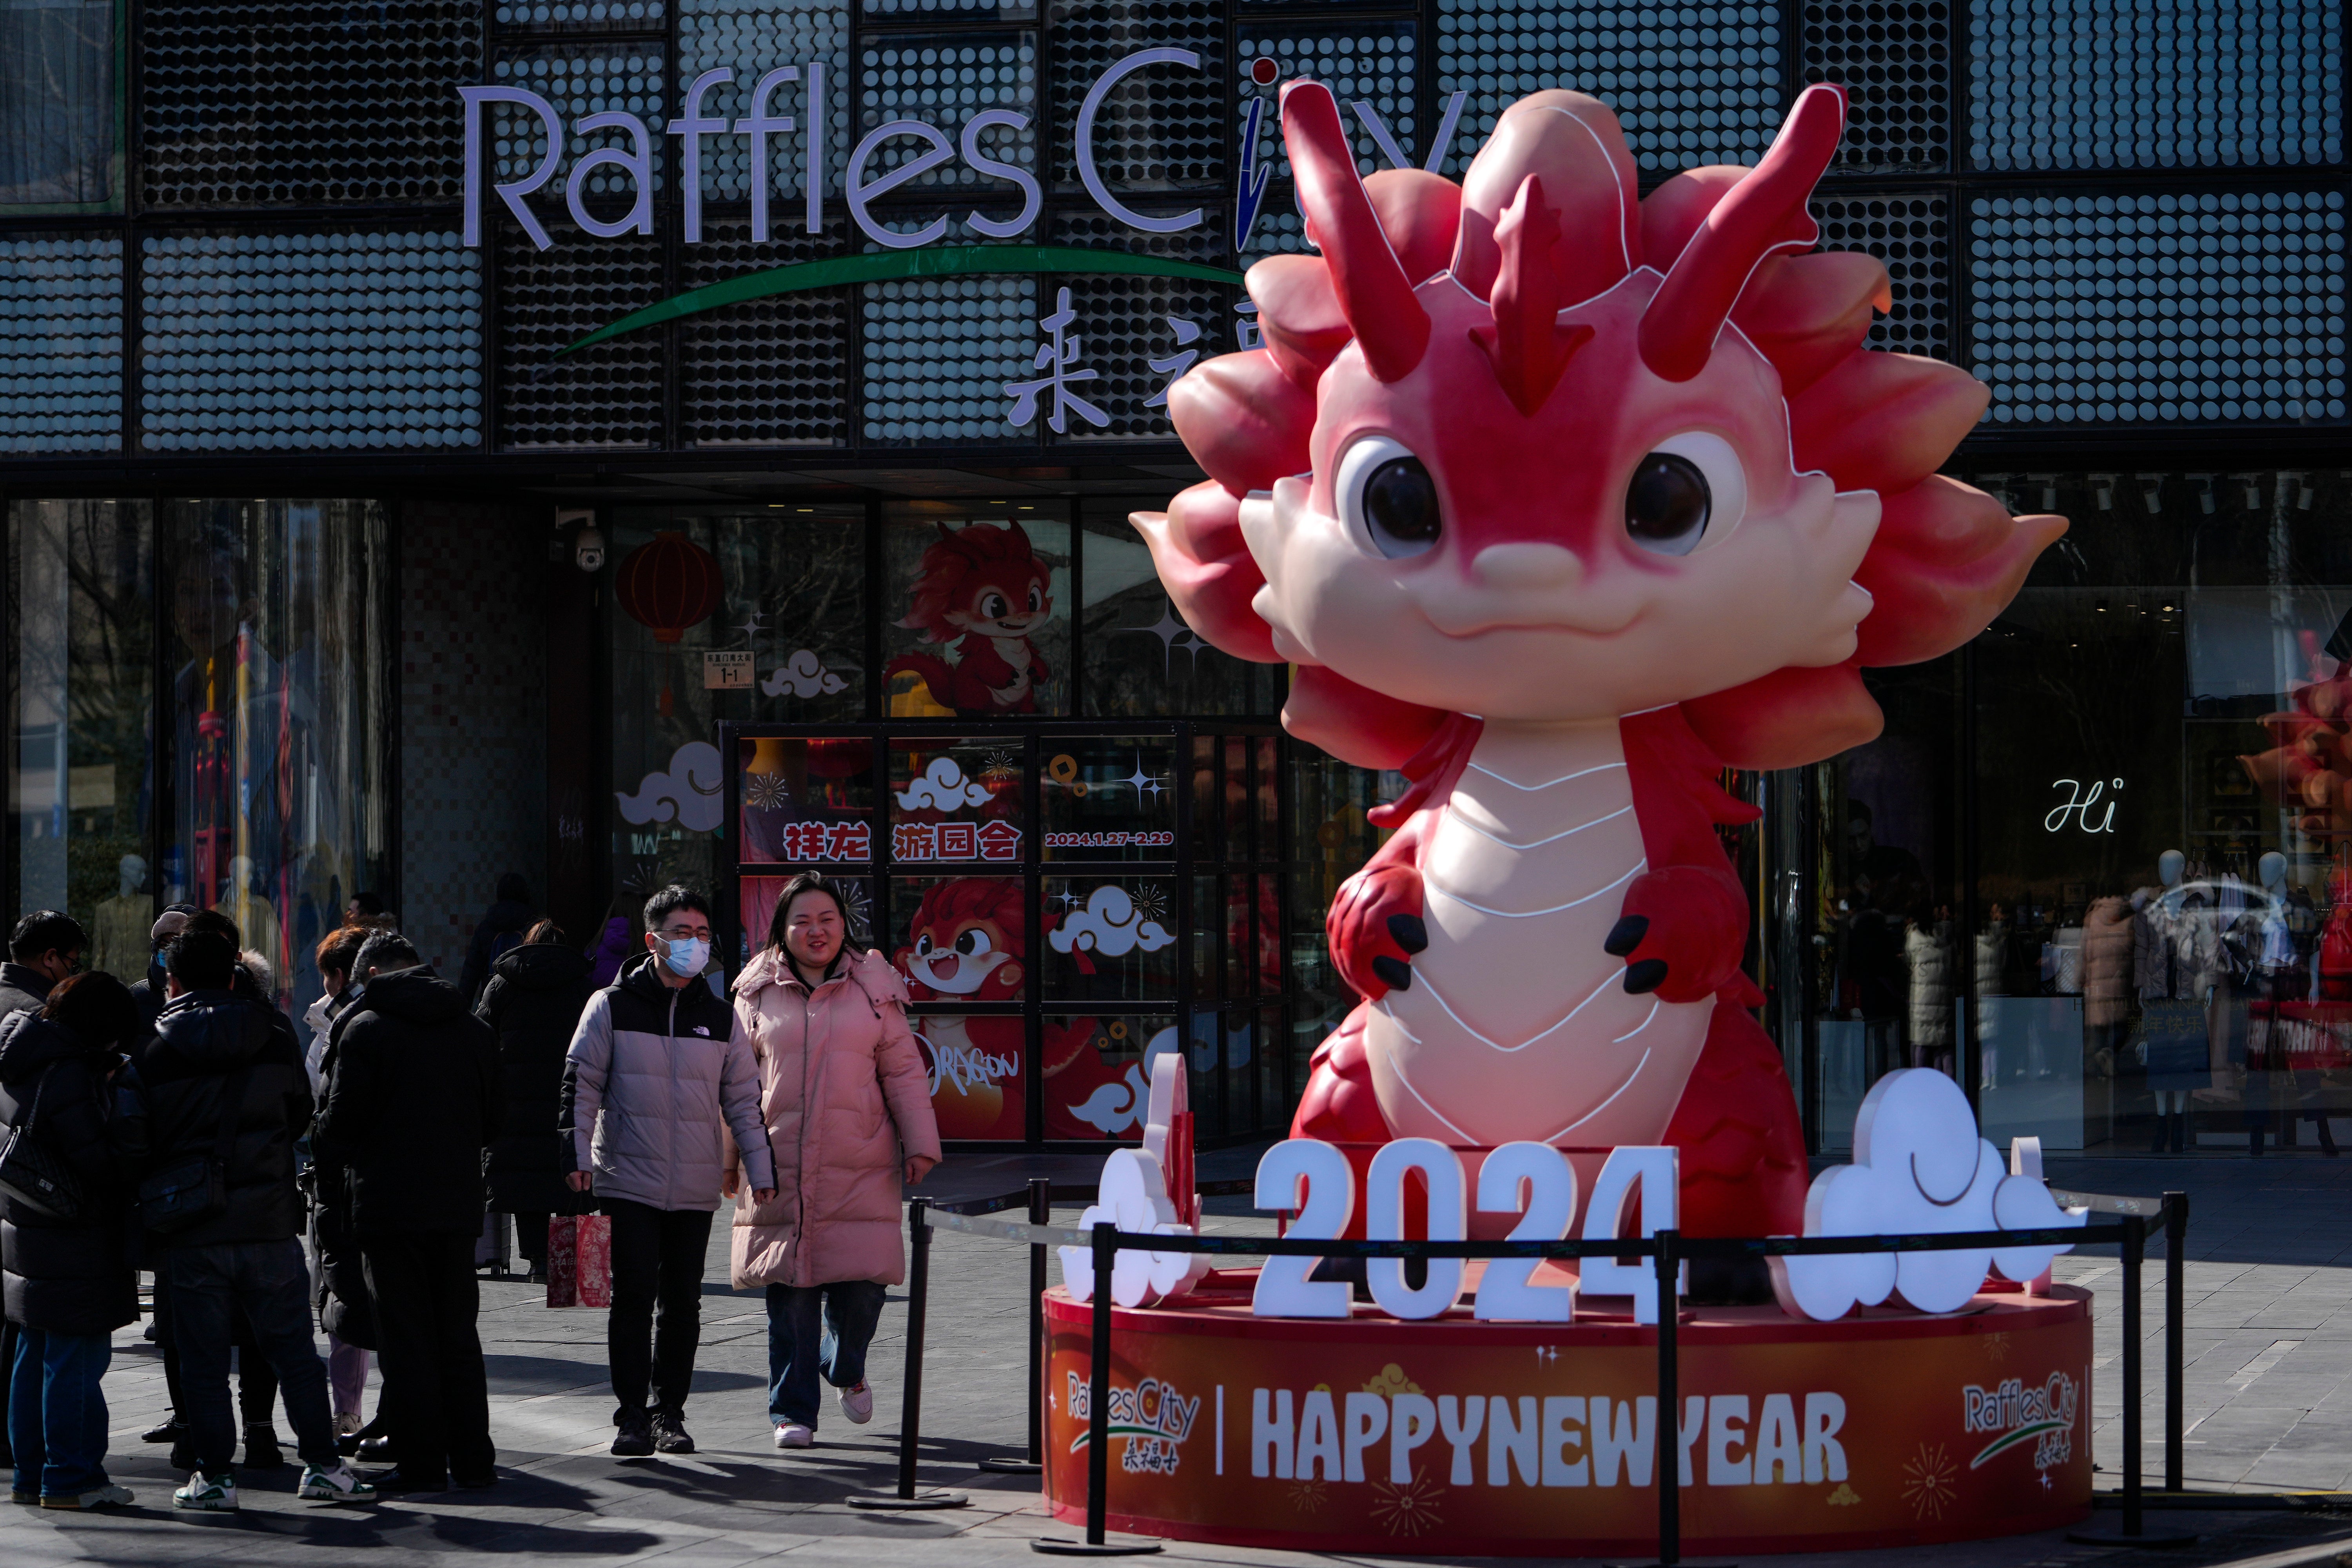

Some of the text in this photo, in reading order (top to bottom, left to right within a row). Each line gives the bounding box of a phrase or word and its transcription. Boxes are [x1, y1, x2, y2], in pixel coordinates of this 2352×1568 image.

[456, 47, 1468, 254] Raffles Ciy
[721, 668, 737, 683] 1-1
[2044, 777, 2124, 833] Hi
[784, 820, 1023, 861] 祥龙 游园会
[1045, 831, 1174, 847] 2024.1.27-2.29
[1253, 1137, 1686, 1324] 2024
[1068, 1372, 1198, 1438] Raes City
[1965, 1373, 2079, 1429] Raffles City
[1123, 1435, 1178, 1472] 来福士
